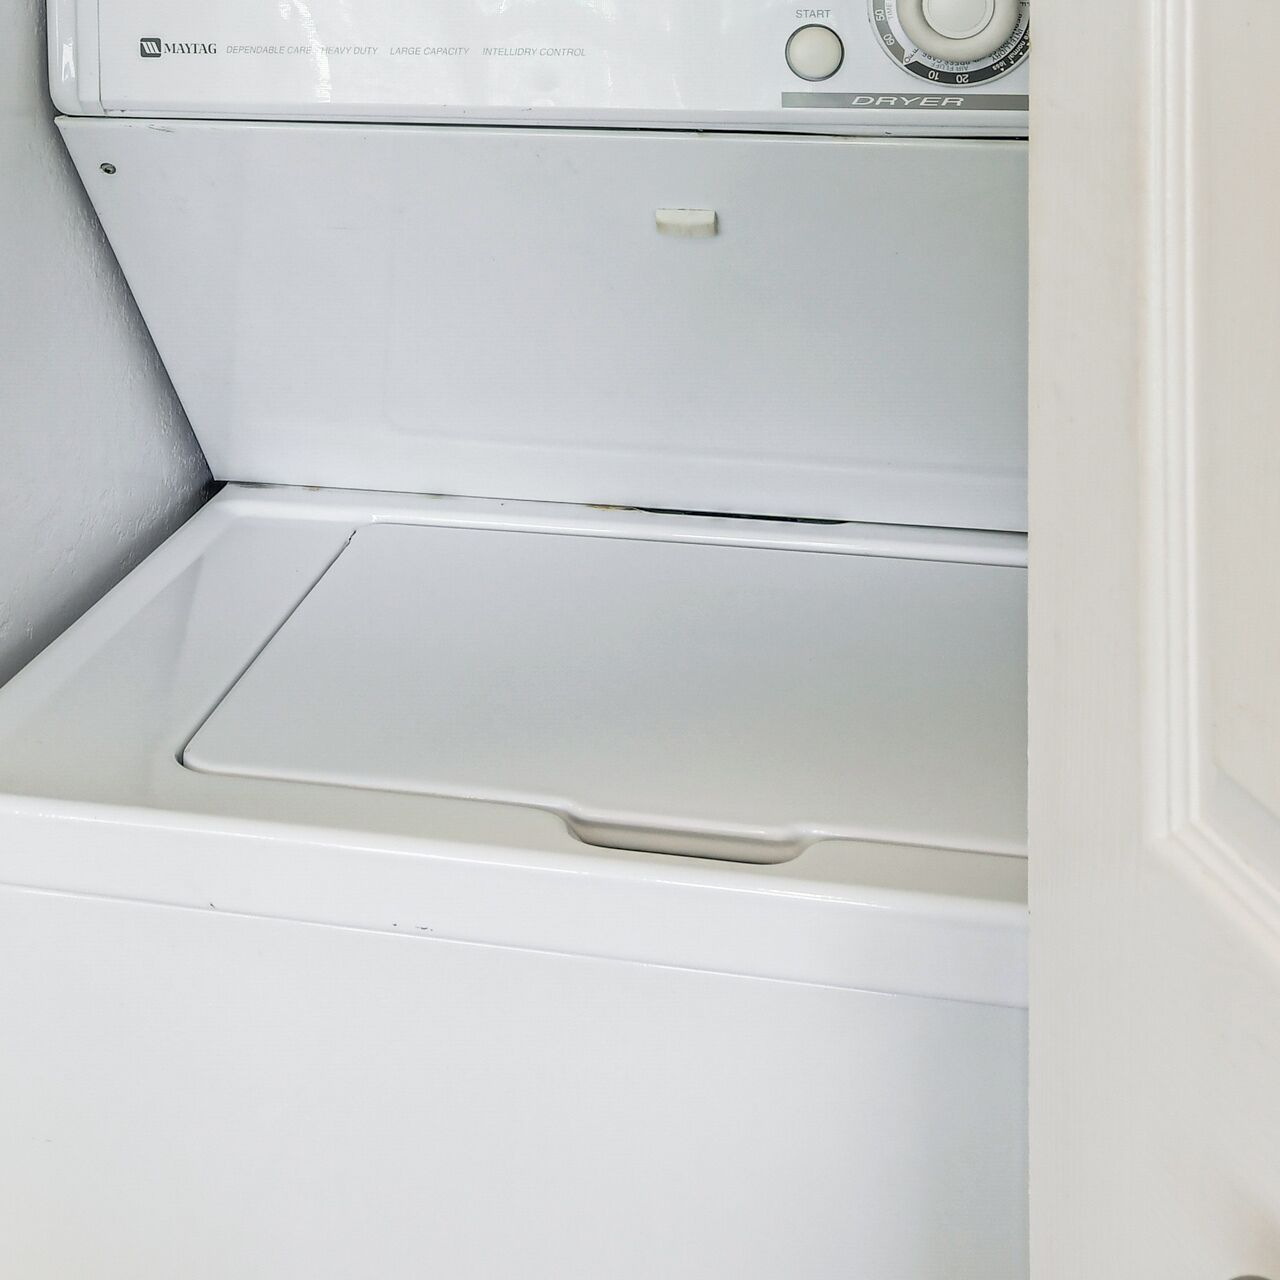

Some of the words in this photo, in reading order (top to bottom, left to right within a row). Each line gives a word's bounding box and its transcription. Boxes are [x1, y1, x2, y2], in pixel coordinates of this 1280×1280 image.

[795, 9, 831, 19] START
[874, 9, 885, 21] 50
[883, 33, 895, 46] 60
[164, 43, 217, 54] MAYTAG
[226, 45, 285, 55] DEPENDABLE
[287, 45, 312, 55] CARE
[320, 46, 353, 55] HEAVY
[354, 46, 379, 55] DUTY
[389, 47, 421, 56] LARGE
[423, 47, 471, 56] CAPACITY
[482, 47, 537, 57] INTELLIDRY
[539, 48, 586, 57] CONTROL
[928, 70, 940, 80] 10
[956, 73, 970, 83] 20
[851, 96, 965, 108] DRYER
